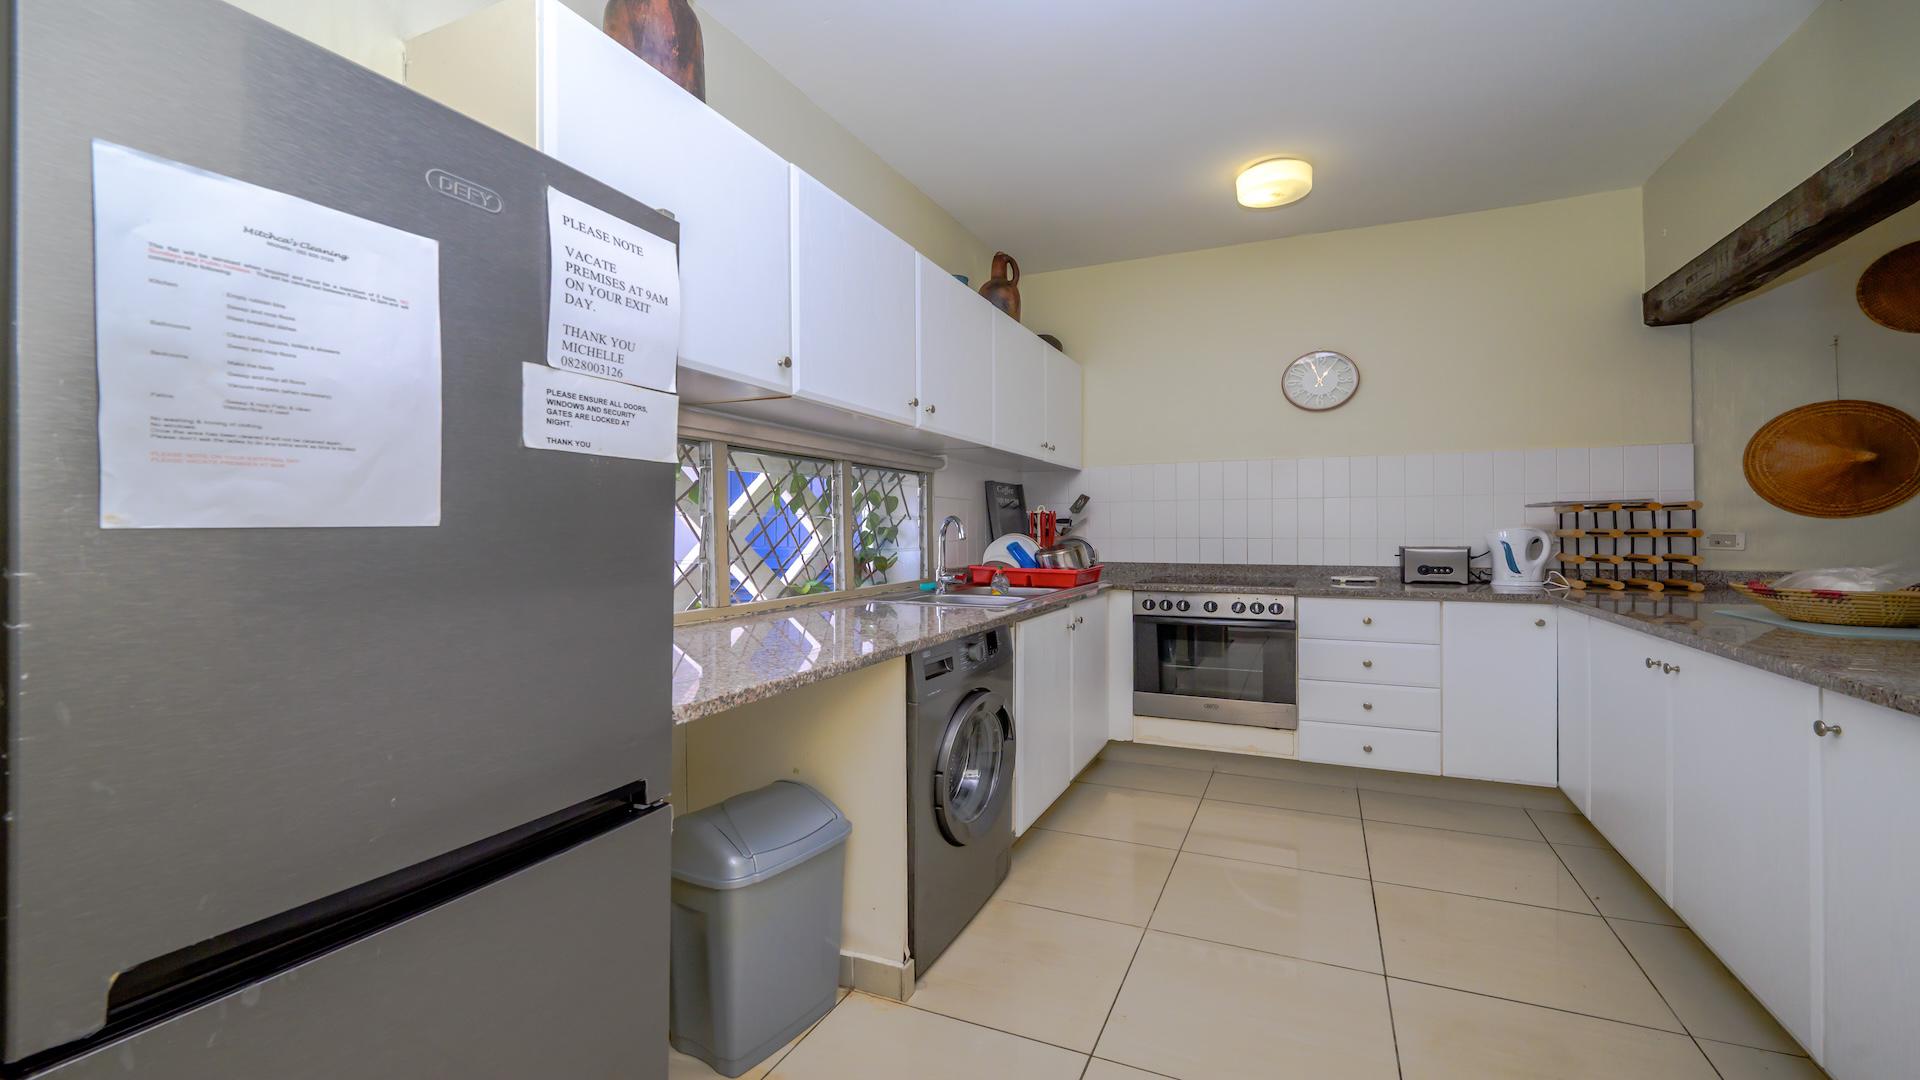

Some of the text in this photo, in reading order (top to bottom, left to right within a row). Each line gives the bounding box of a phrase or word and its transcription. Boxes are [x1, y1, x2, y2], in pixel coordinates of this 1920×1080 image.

[440, 175, 493, 207] DEFY
[562, 214, 644, 257] PLEASE NOTE
[300, 242, 349, 261] Cleaning
[565, 245, 617, 274] VACATE
[565, 261, 669, 306] PREMISES AT 9AM
[565, 277, 652, 314] ON YOUR EXIT
[565, 292, 596, 312] DAY.
[562, 323, 636, 352] THANK YOU
[562, 340, 625, 365] MICHELLE
[560, 355, 623, 379] 0828003126
[546, 388, 648, 413] PLEASE ENSURE ALL DOORS,
[546, 399, 636, 419] WINDOWS AND SECURITY
[546, 409, 573, 418] GATES
[575, 413, 590, 421] ARE
[591, 415, 620, 426] LOCKED
[546, 418, 573, 428] NIGHT.
[547, 437, 573, 446] THANK
